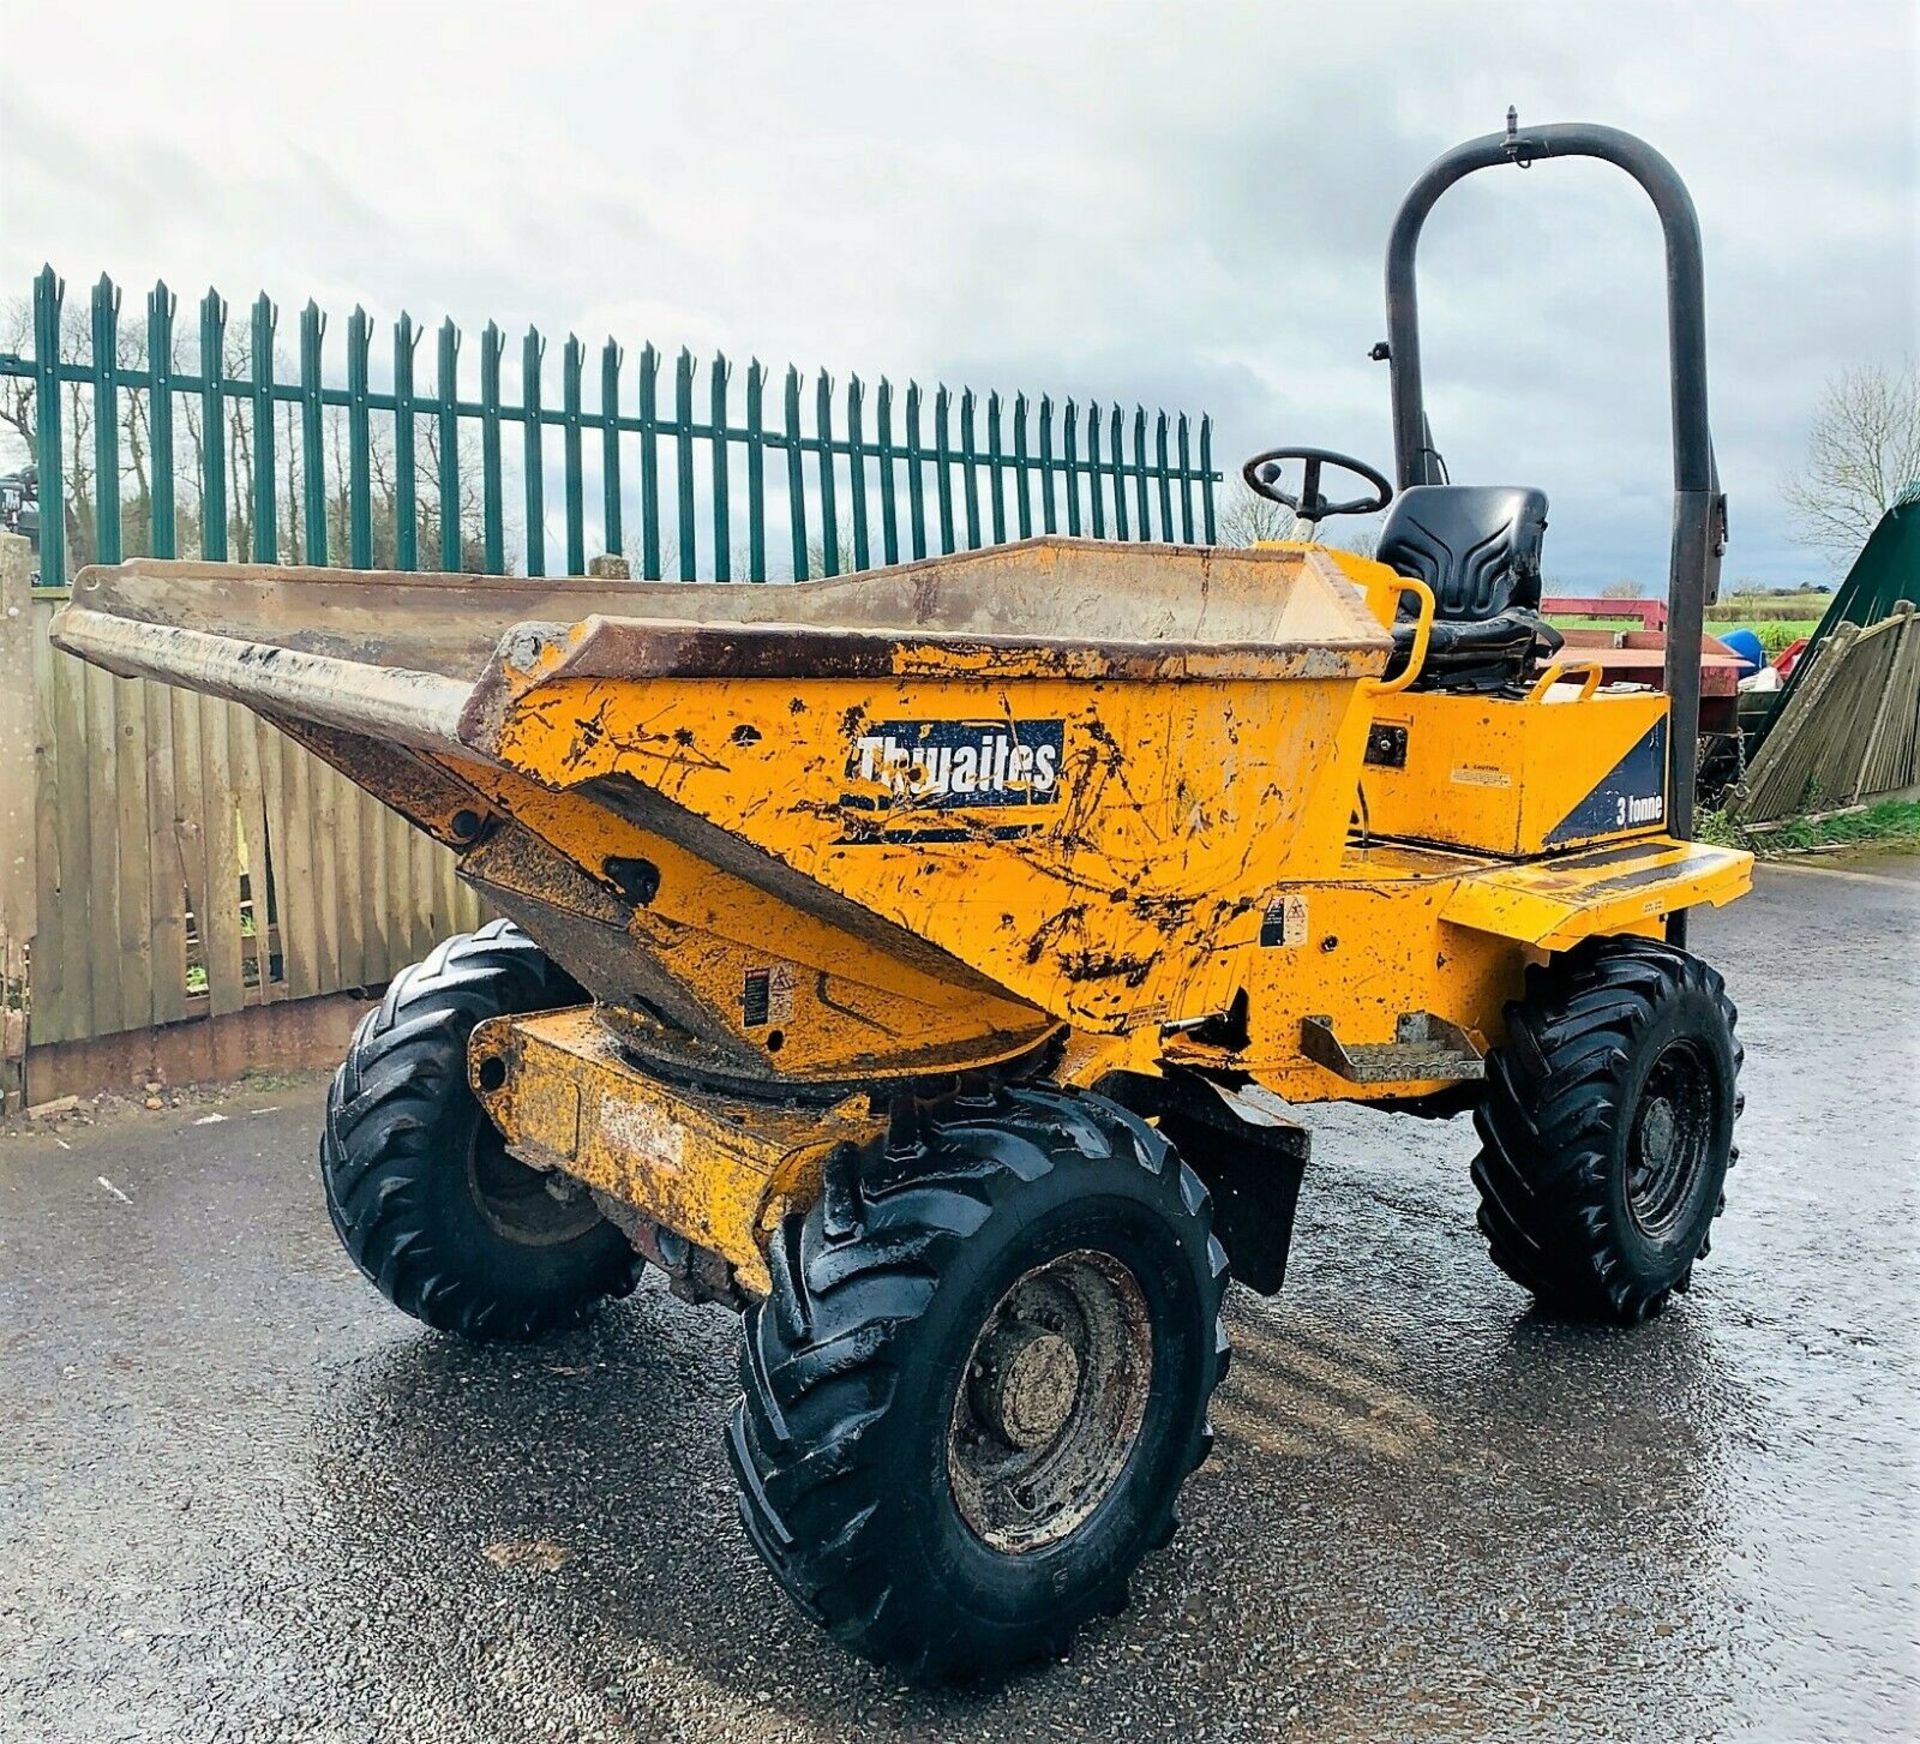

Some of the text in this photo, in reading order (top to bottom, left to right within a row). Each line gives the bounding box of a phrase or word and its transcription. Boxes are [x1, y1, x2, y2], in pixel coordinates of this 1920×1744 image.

[857, 735, 1056, 794] Thwaites
[1616, 795, 1663, 826] 3 tonne
